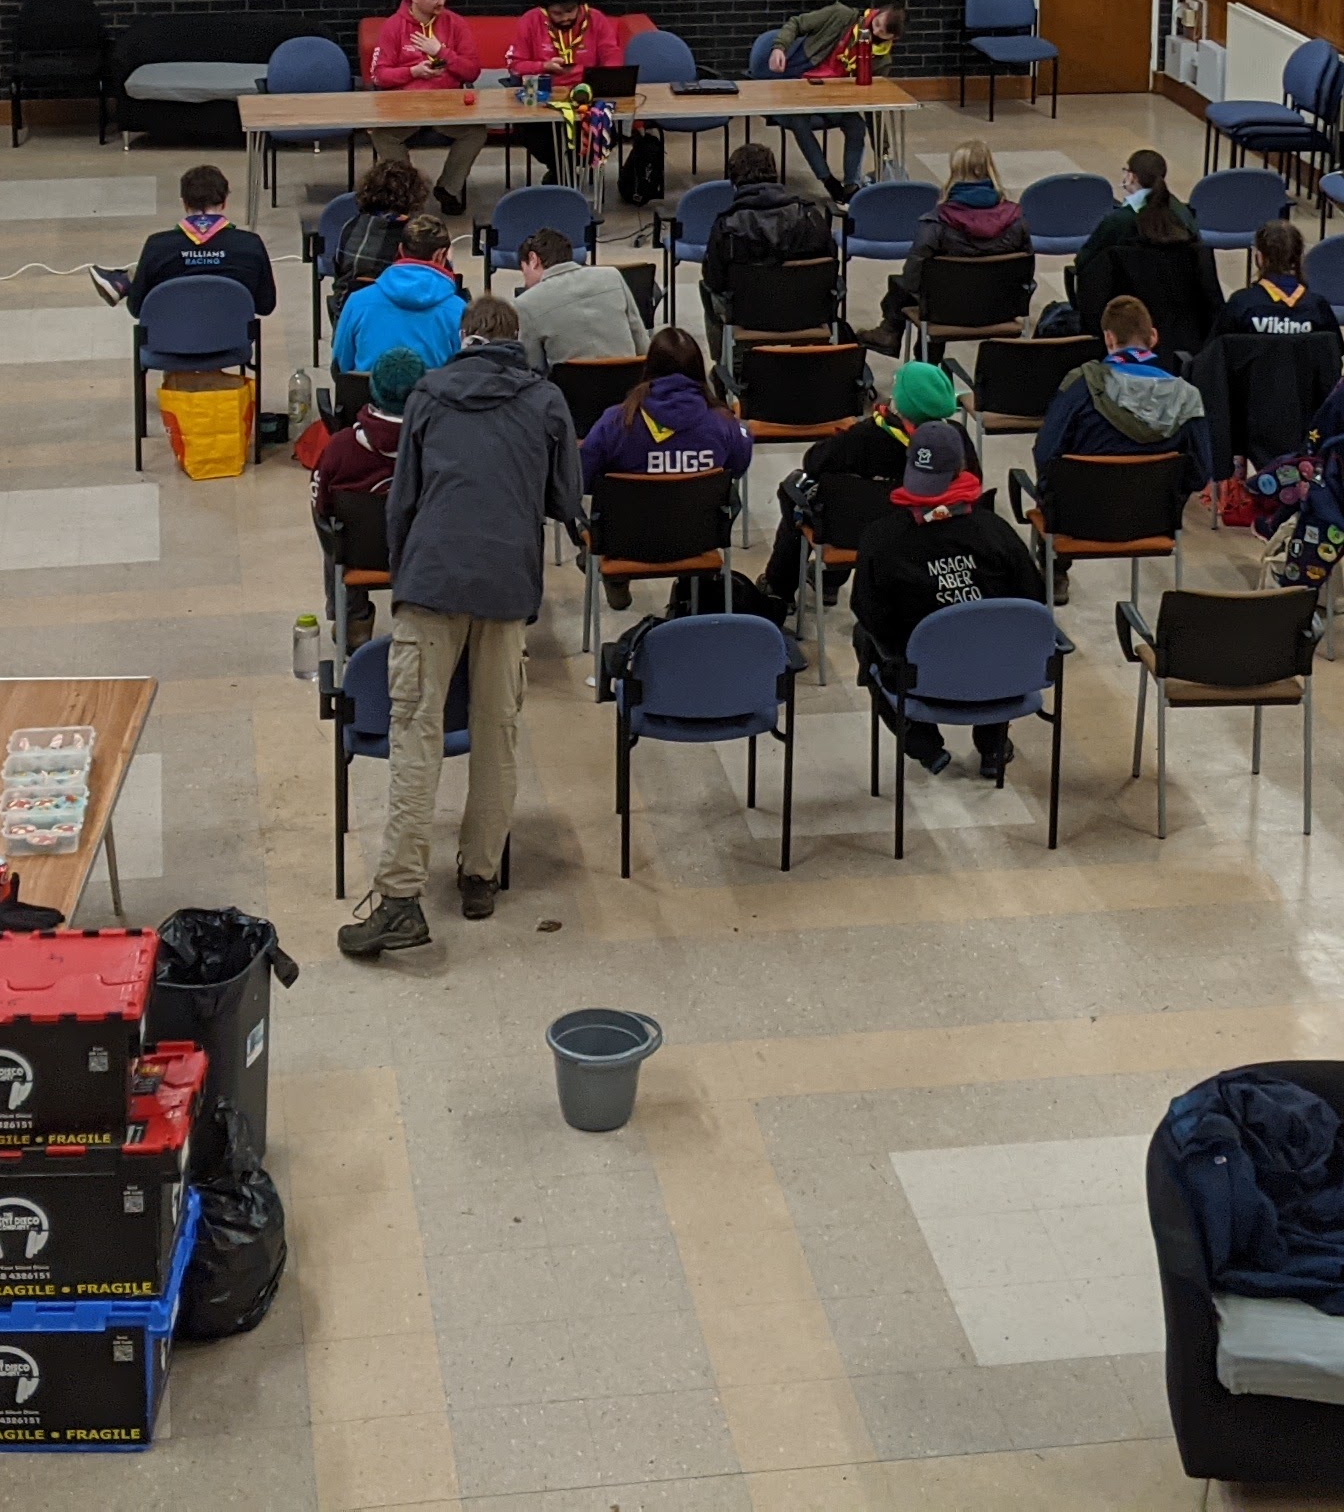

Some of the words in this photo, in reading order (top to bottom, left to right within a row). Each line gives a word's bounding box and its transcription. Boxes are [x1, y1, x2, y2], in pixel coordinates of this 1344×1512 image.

[181, 250, 225, 258] WILLIAMS
[184, 257, 221, 265] RACING
[647, 449, 714, 473] BUGS
[927, 554, 976, 576] MSAGM
[937, 570, 973, 591] ABER
[48, 1134, 111, 1144] FRAGILE
[77, 1282, 152, 1294] FRAGILE
[66, 1428, 140, 1439] FRAGILE
